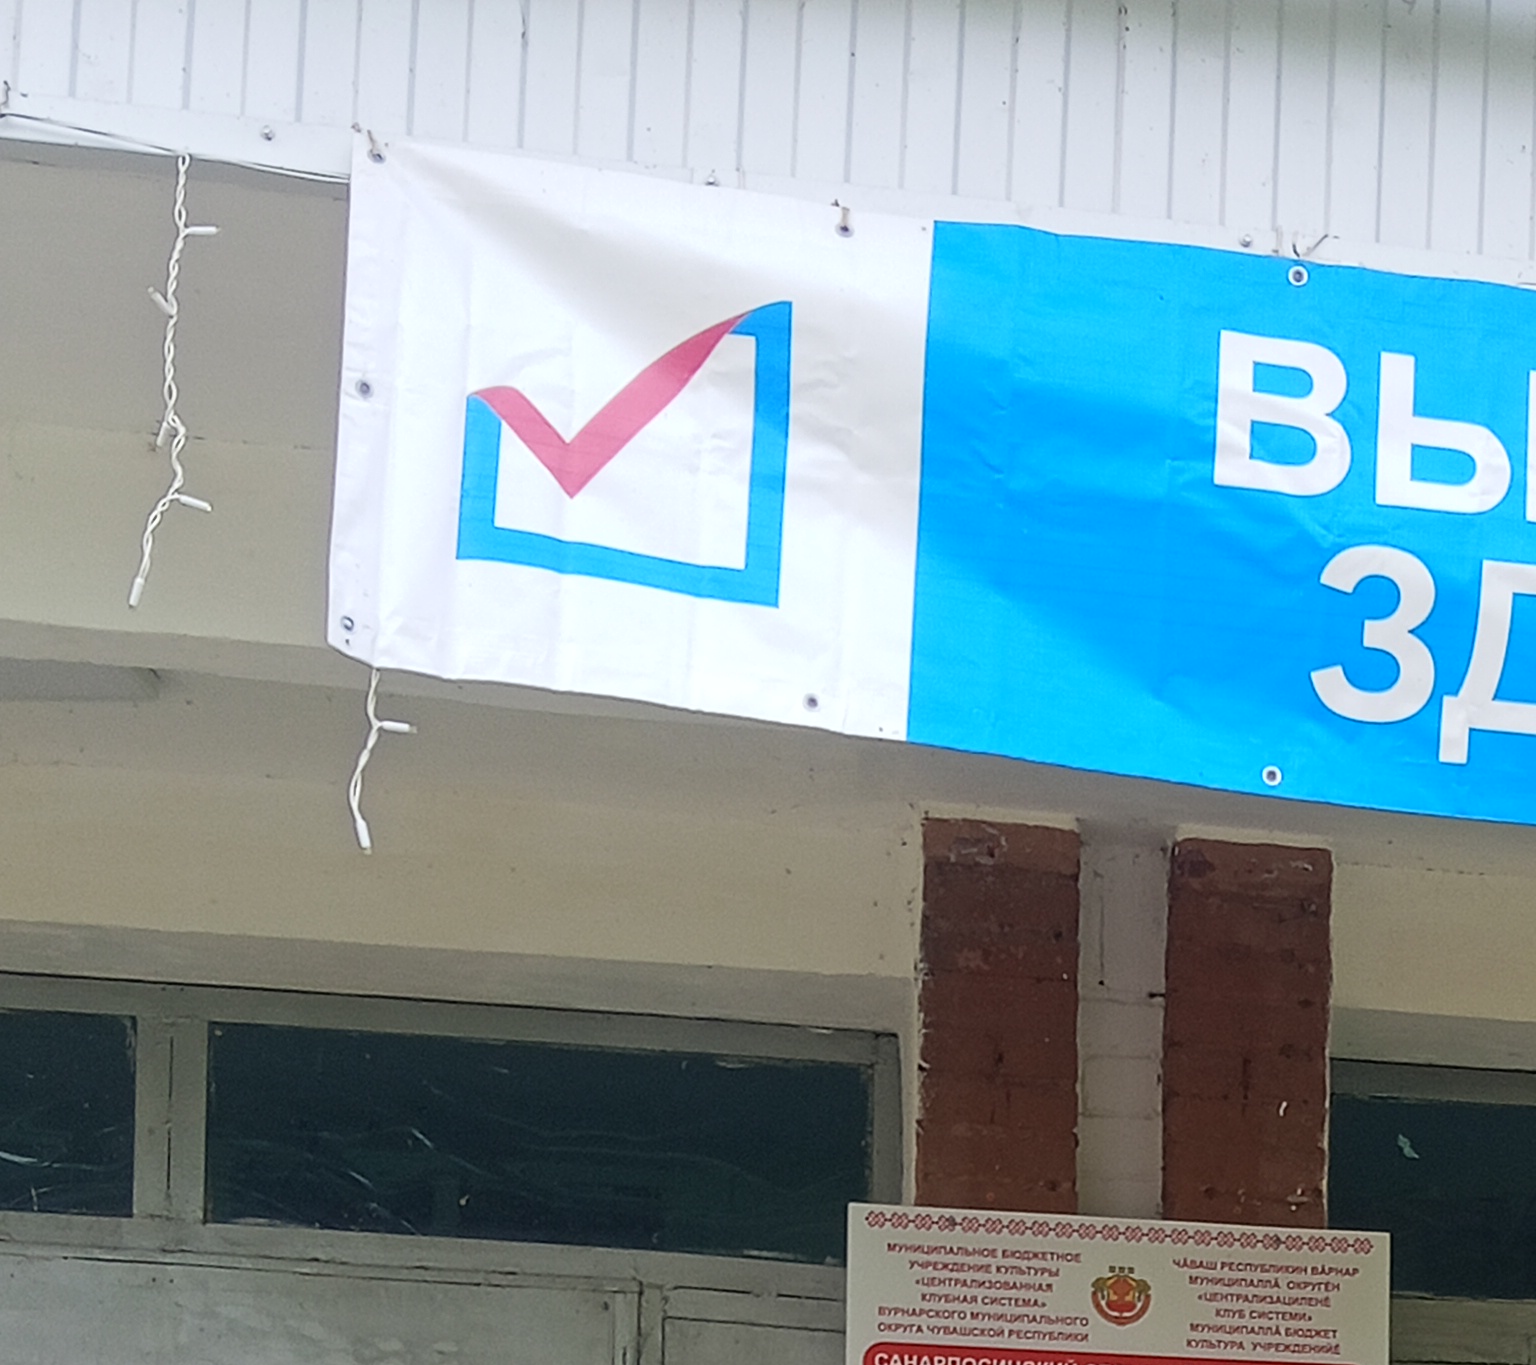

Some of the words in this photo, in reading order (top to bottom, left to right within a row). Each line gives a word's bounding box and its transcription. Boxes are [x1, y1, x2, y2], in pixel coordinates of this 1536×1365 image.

[886, 1242, 998, 1260] МУНИЦИПАЛЬНОЕ
[1001, 1248, 1082, 1264] БЮДЖЕТНОЕ
[908, 1260, 992, 1275] УЧРЕЖДЕНИЕ
[995, 1265, 1060, 1278] КУЛЬТУРЫ
[1220, 1261, 1308, 1276] РЕСПУБЛИКИН
[915, 1277, 1053, 1294] «ЦЕНТРАЛИЗОВАННАЯ
[920, 1292, 978, 1305] КЛУБНАЯ
[981, 1295, 1047, 1309] СИСТЕМА»
[877, 1306, 967, 1321] ВУРНАРСКОГО
[970, 1311, 1089, 1328] МУНИЦИПАЛЬНОГО
[1215, 1307, 1246, 1320] КЛУБ
[877, 1322, 925, 1335] ОКРУГА
[927, 1323, 1004, 1338] ЧУВАШСКОЙ
[1007, 1328, 1089, 1343] РЕСПУБЛИКИ
[1284, 1326, 1338, 1340] БЮДЖЕТ
[1186, 1338, 1245, 1351] КУЛЬТУРА
